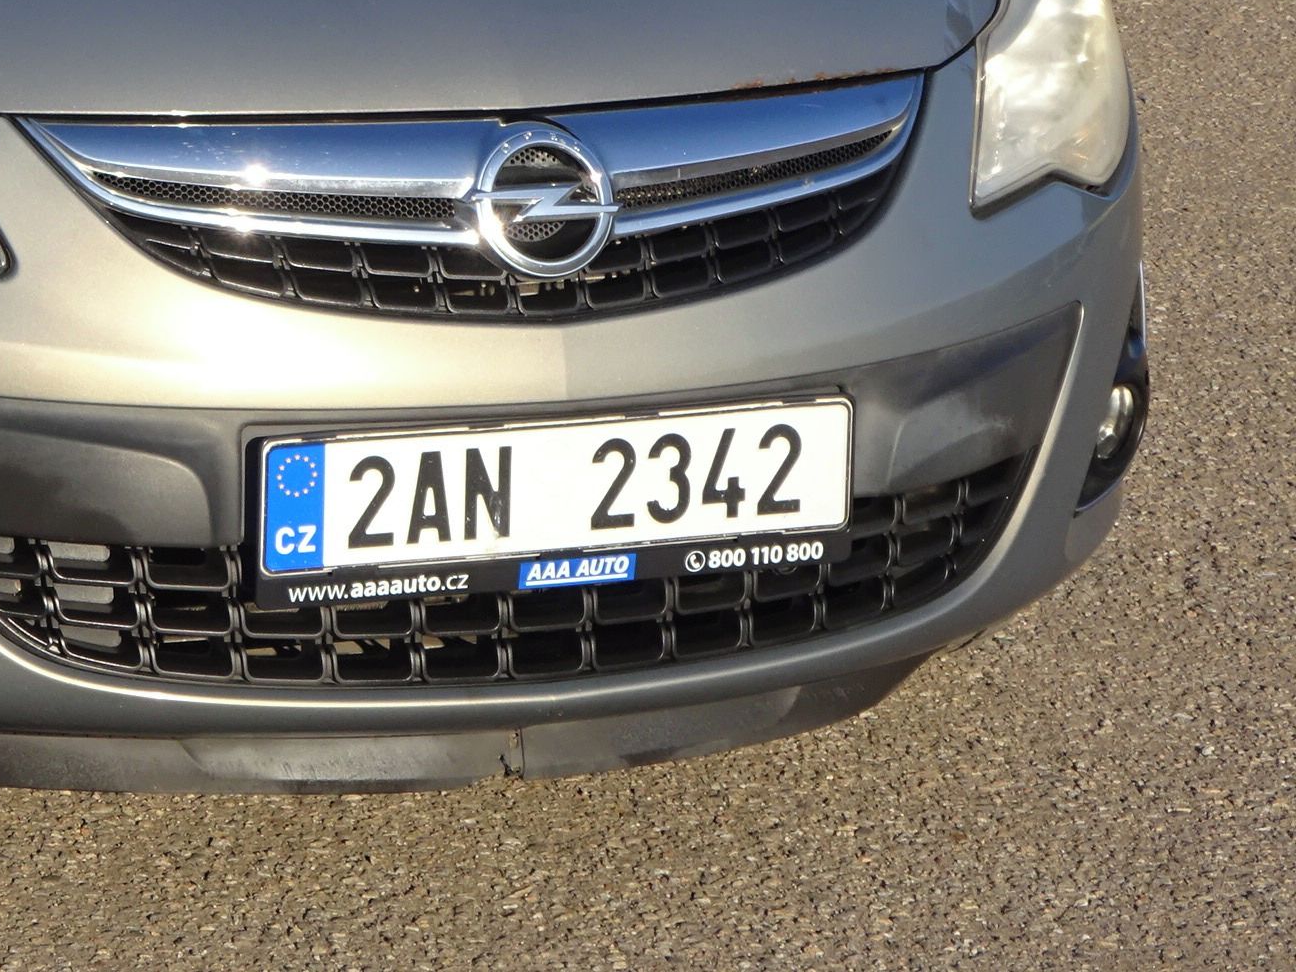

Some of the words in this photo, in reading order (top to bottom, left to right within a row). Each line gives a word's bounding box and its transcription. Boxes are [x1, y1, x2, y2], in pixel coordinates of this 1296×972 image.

[348, 446, 512, 549] 2AN
[590, 423, 802, 530] 2342
[275, 524, 317, 555] CZ
[527, 563, 571, 581] AAA
[575, 555, 630, 576] AUTO
[708, 549, 747, 569] 800
[751, 545, 781, 565] 110
[786, 541, 824, 561] 800
[288, 574, 469, 603] www.aaaauto.cz
